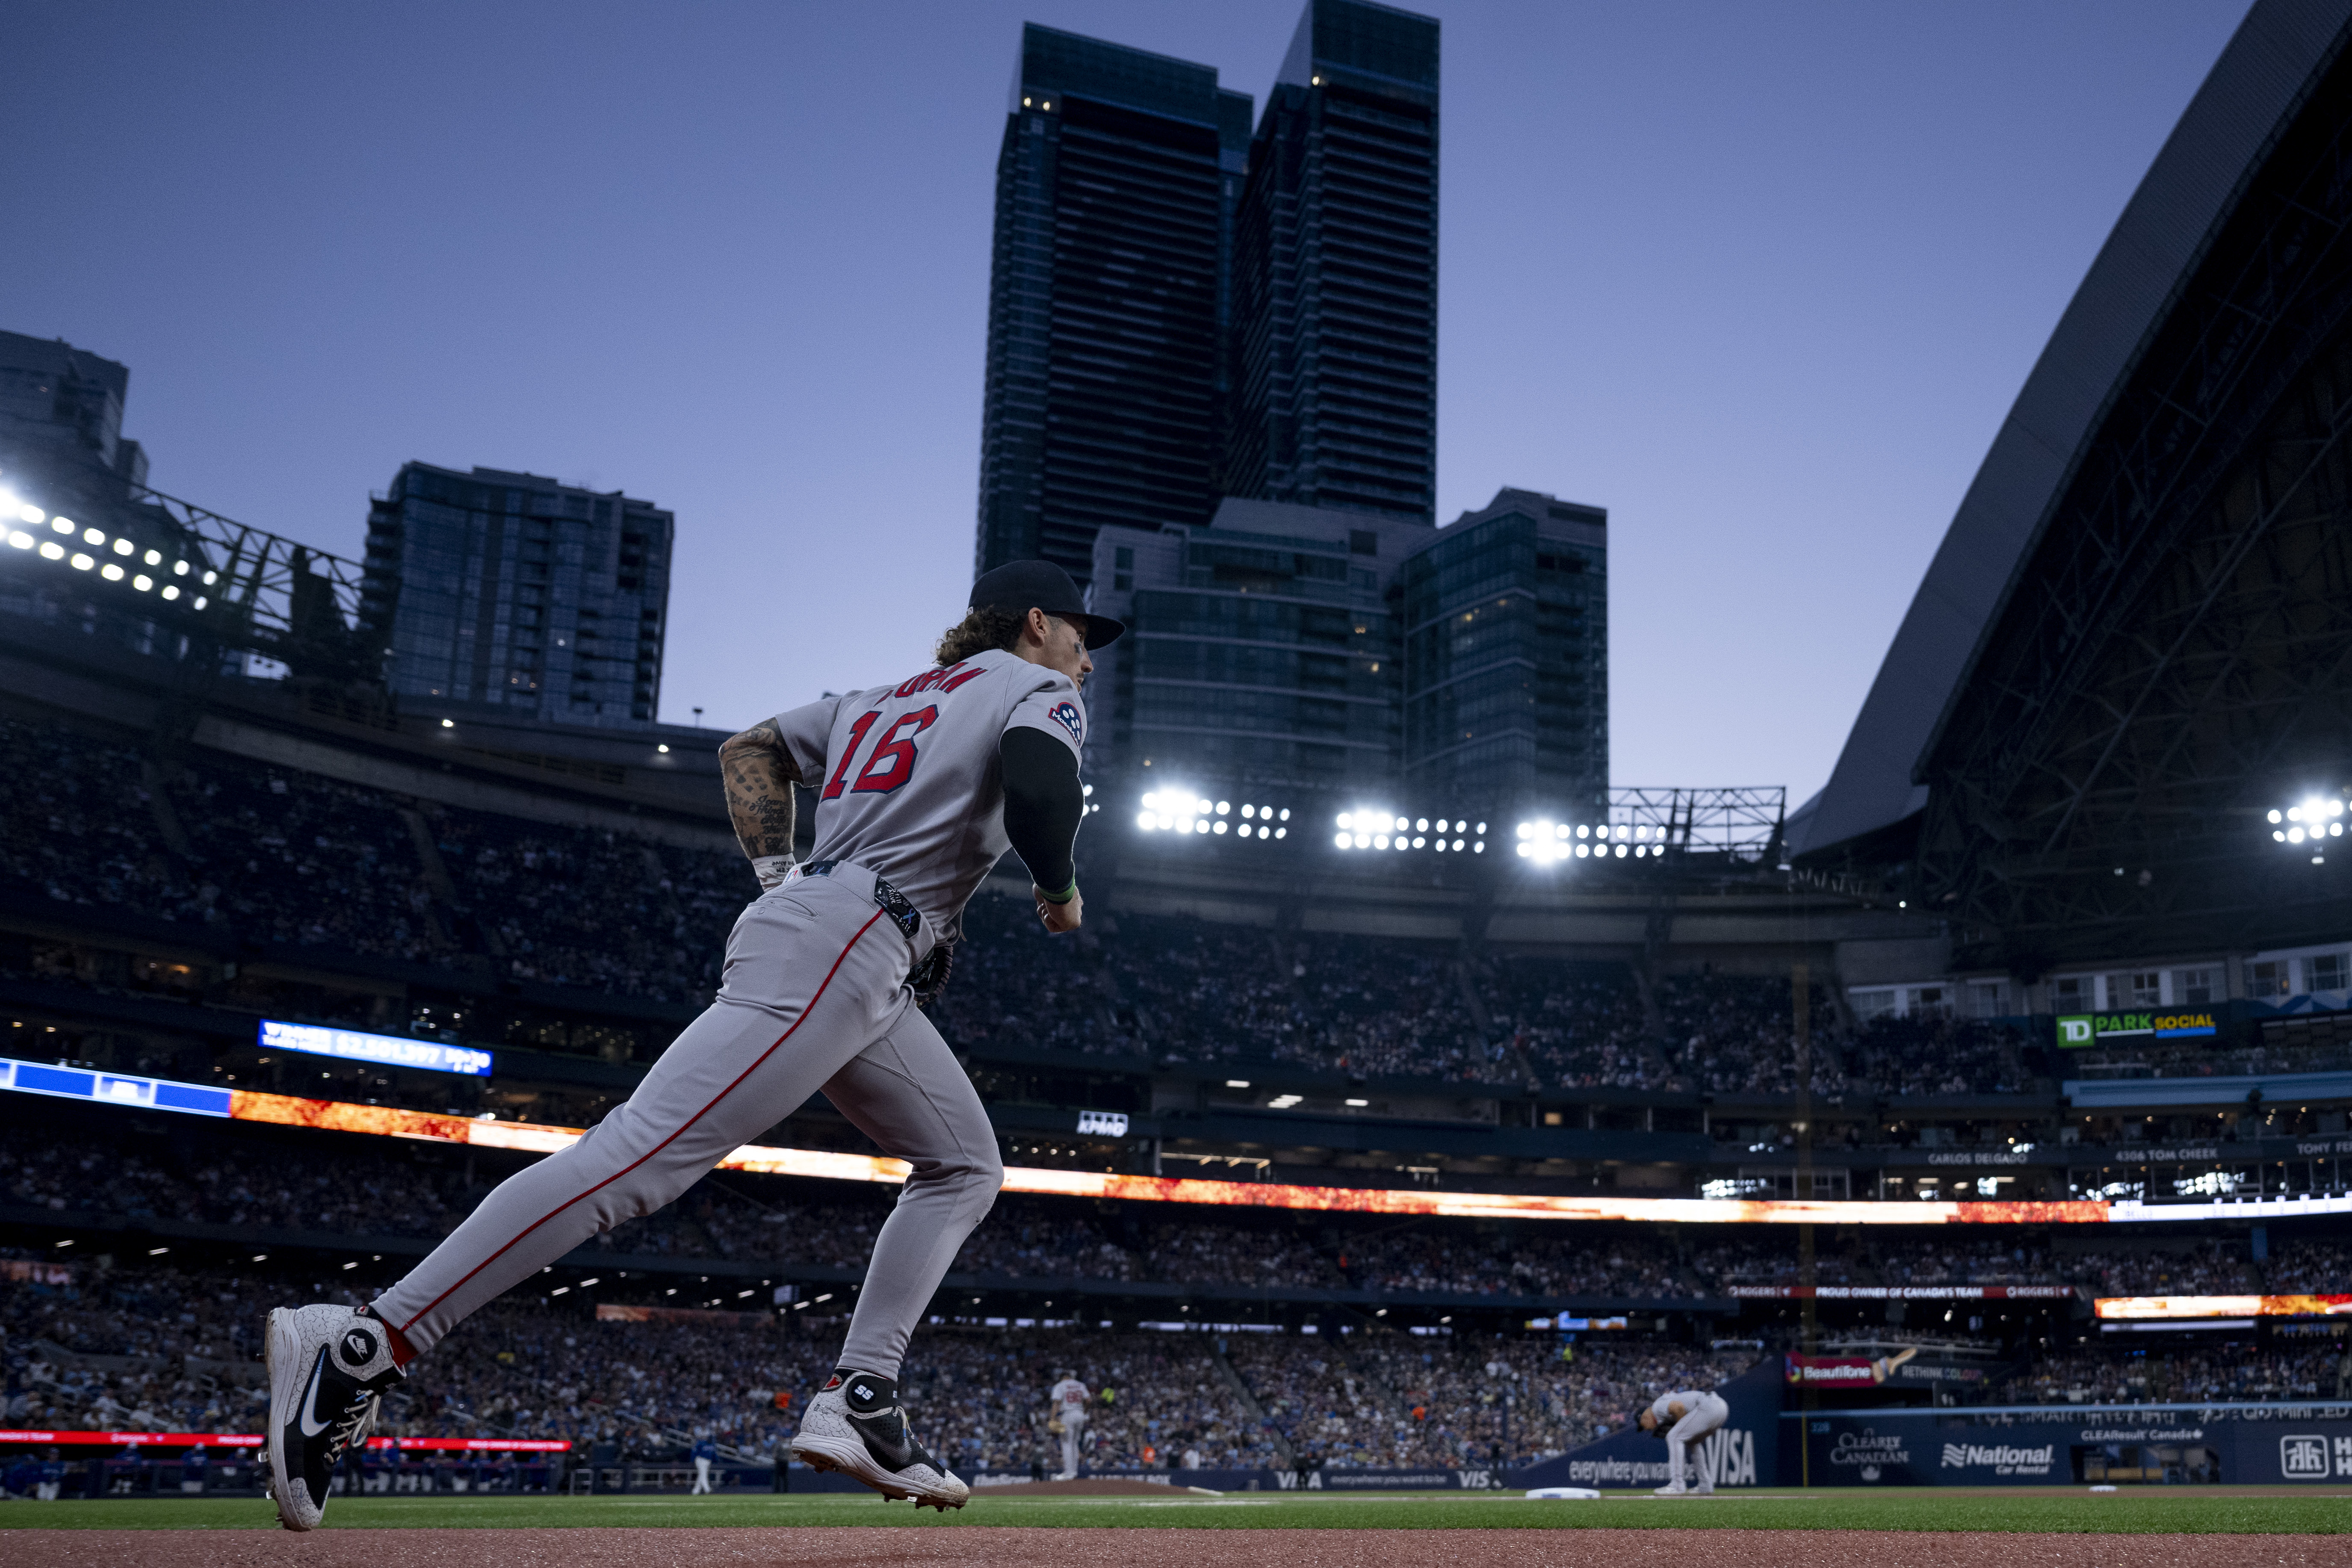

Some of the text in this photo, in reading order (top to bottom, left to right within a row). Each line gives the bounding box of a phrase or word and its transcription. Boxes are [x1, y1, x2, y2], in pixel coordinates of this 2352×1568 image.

[821, 704, 939, 803] 16
[887, 889, 896, 904] Alive
[2060, 1013, 2216, 1041] TD PARK SOCIAL
[1077, 1119, 1126, 1137] KPMG
[2148, 1149, 2176, 1161] TOM
[2178, 1148, 2218, 1160] CHEEK
[2296, 1143, 2330, 1155] TONY
[1927, 1152, 2027, 1165] CARLOS DELGADO
[1739, 1286, 1776, 1297] ROGERS
[1816, 1287, 1983, 1298] PROUD OWNER OF CANADA'S TEAM
[2017, 1286, 2054, 1298] ROGERS
[355, 1337, 368, 1355] NIKE
[1902, 1365, 1943, 1378] RETHINK
[854, 1385, 874, 1400] SS
[1839, 1432, 1901, 1450] CLEARLY
[2149, 1428, 2192, 1441] Canada
[1705, 1427, 1757, 1485] VISA
[1830, 1447, 1909, 1465] CANADIAN
[1967, 1444, 2053, 1465] National
[1569, 1455, 1630, 1486] everywhere
[1630, 1461, 1649, 1486] you
[1649, 1462, 1669, 1481] wan
[1995, 1464, 2050, 1475] Car Rental
[1275, 1471, 1323, 1490] VIA
[1330, 1474, 1383, 1488] everywhere
[1383, 1476, 1400, 1488] you
[1457, 1471, 1490, 1489] VIS
